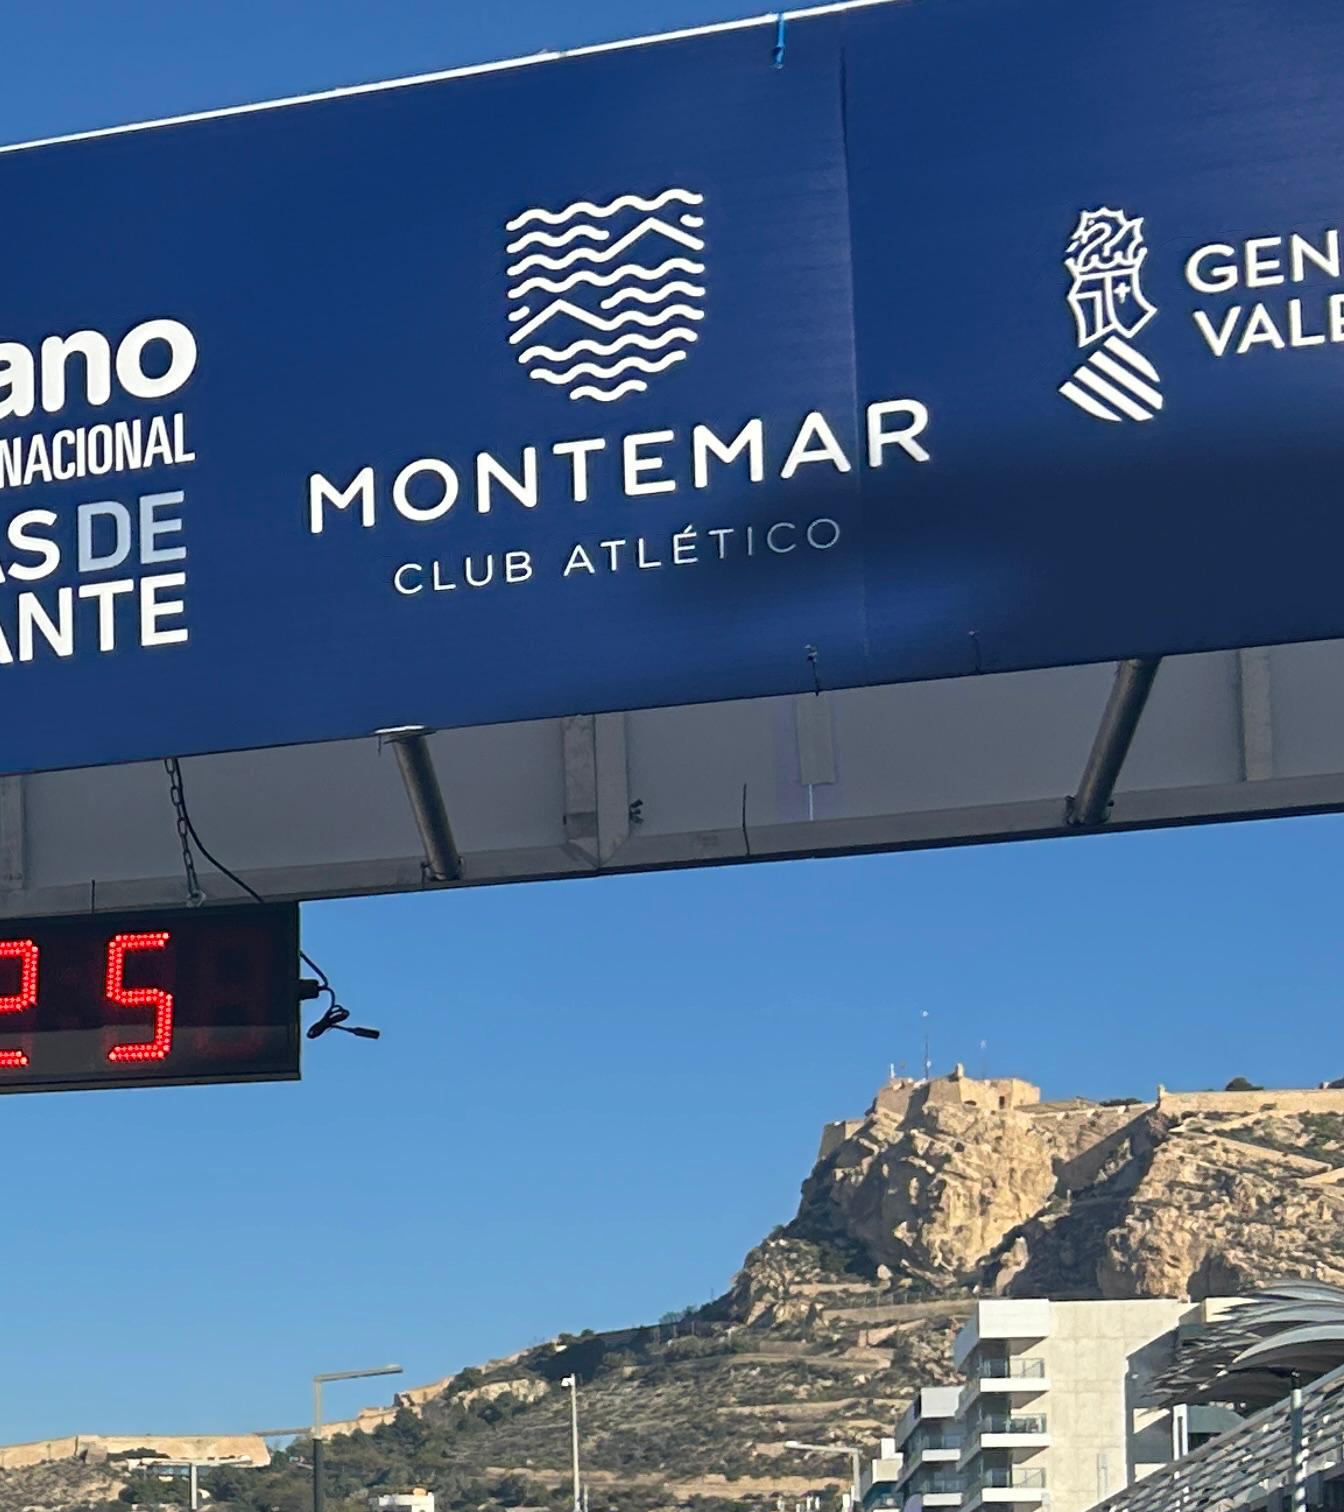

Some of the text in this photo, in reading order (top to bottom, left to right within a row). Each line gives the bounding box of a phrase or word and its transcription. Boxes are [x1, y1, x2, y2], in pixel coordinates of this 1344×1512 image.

[307, 397, 931, 533] MONTEMAR
[392, 515, 842, 596] CLUB ATLÉTICO
[105, 931, 174, 1064] 5
